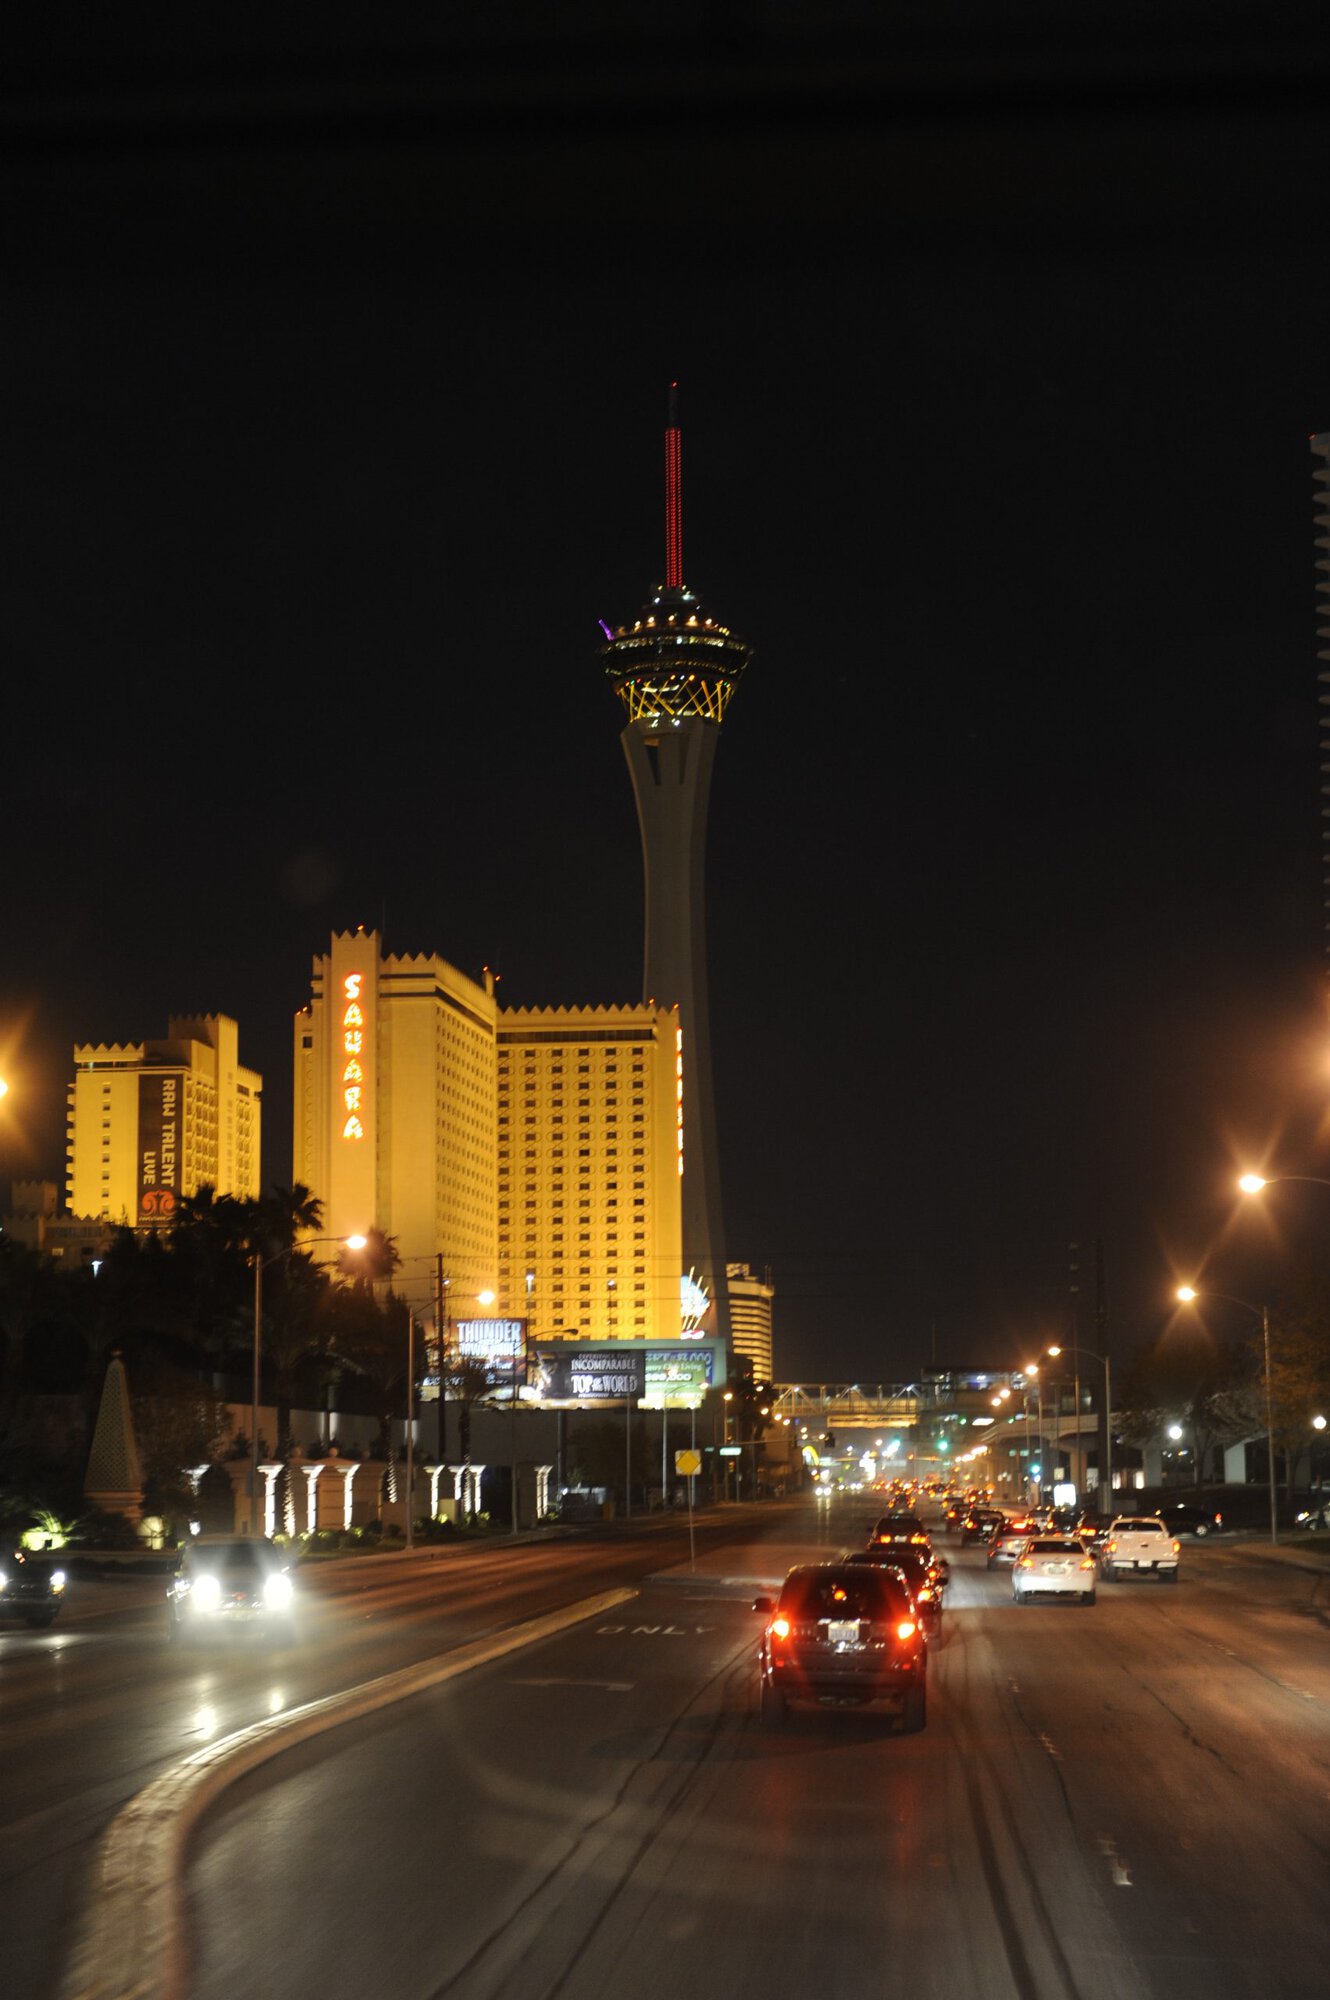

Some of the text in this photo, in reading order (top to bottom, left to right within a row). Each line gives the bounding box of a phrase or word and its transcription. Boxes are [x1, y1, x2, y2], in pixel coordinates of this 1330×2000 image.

[343, 973, 364, 1140] SAHARA
[161, 1079, 176, 1188] RAW TALENT
[143, 1151, 157, 1186] LIVE
[457, 1321, 521, 1343] THUNDER
[571, 1358, 637, 1371] INCOMPARABLE
[571, 1374, 593, 1393] TOP
[602, 1374, 638, 1393] WORLD
[595, 1625, 717, 1635] ONLY
